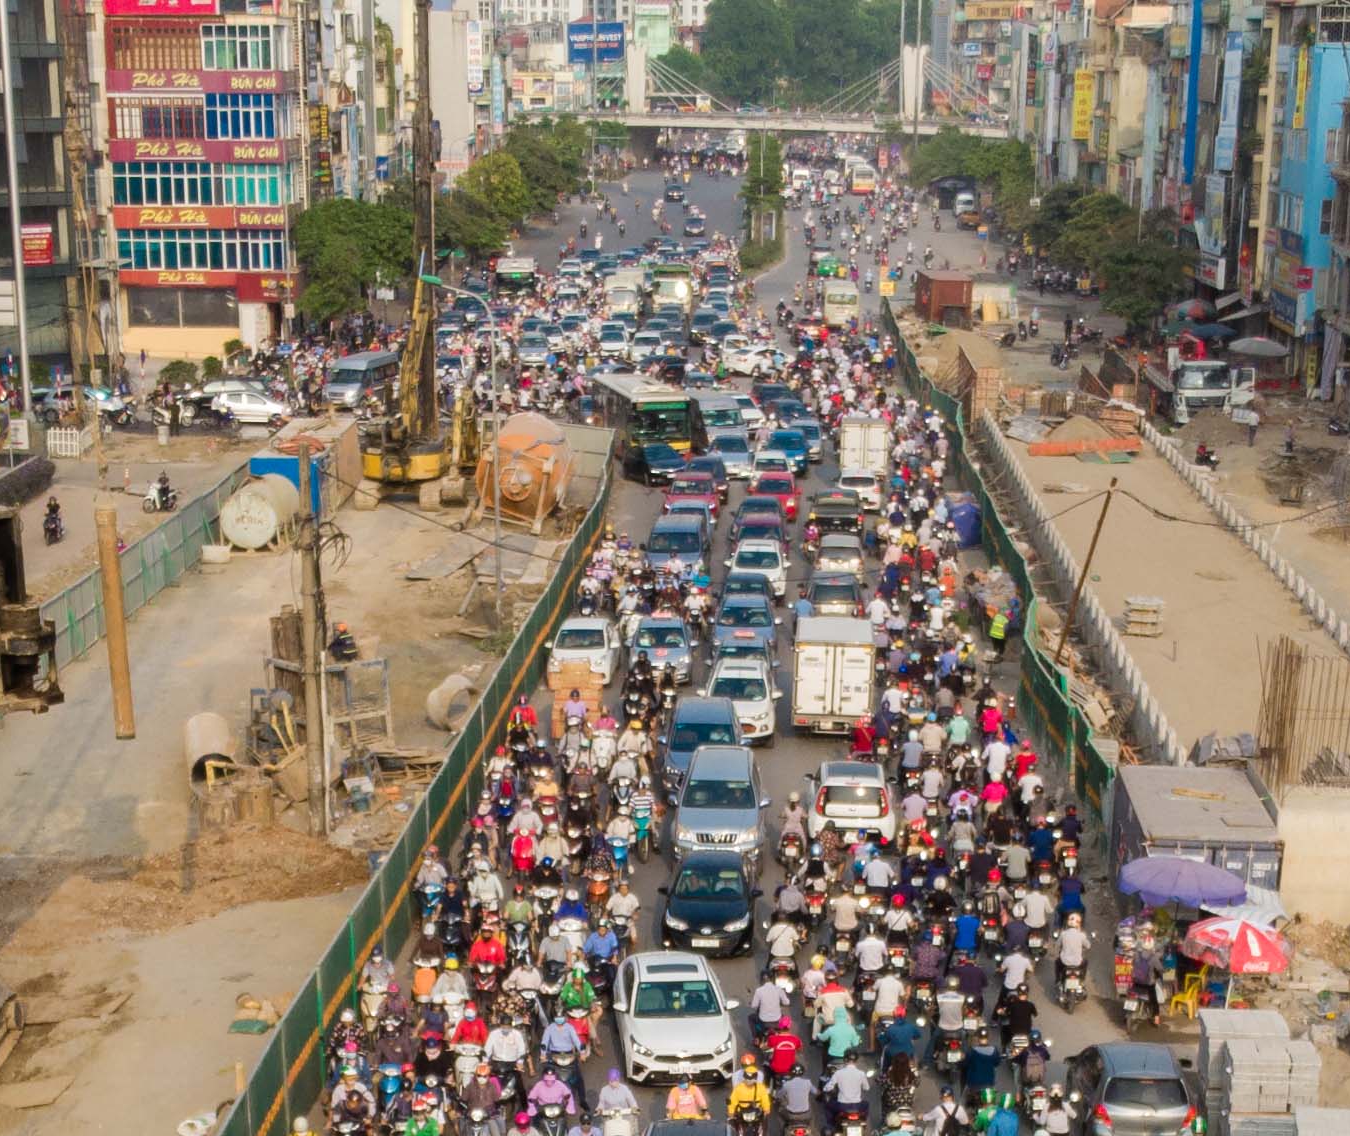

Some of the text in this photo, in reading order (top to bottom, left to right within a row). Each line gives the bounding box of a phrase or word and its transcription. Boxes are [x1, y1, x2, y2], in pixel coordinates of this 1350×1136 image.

[132, 73, 167, 87] Phở
[135, 142, 169, 156] Phở
[139, 209, 172, 224] Phở
